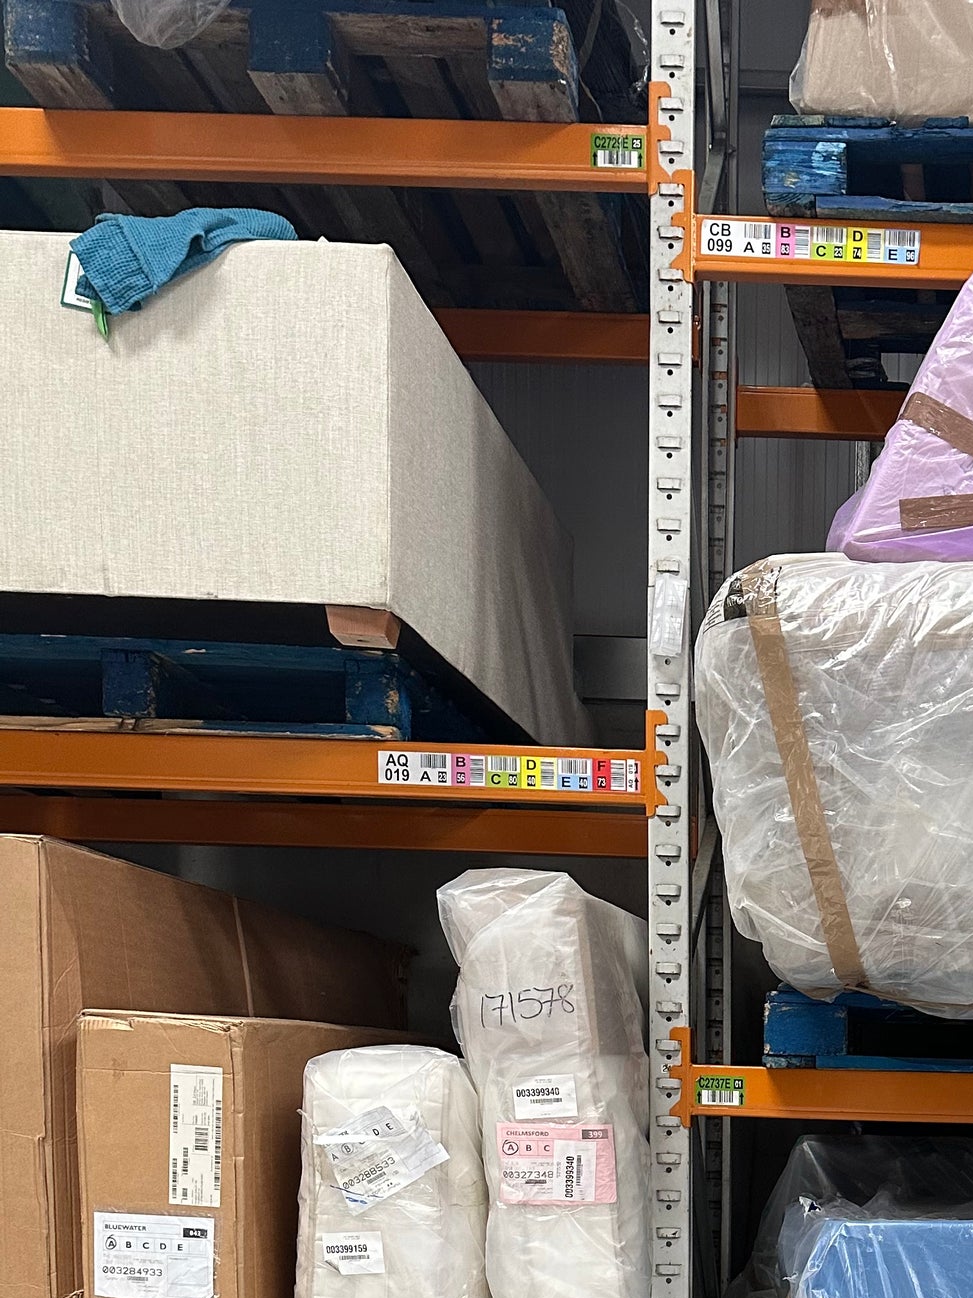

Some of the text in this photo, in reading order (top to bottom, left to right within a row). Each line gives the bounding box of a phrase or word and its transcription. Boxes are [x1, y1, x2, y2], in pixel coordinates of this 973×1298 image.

[633, 139, 641, 148] 25
[710, 223, 731, 236] CB
[781, 227, 790, 238] B
[853, 231, 863, 241] D
[708, 238, 771, 253] 099 A 35
[816, 246, 826, 256] C
[853, 248, 862, 258] 74
[888, 249, 915, 261] E 96
[386, 754, 408, 767] AQ
[456, 757, 466, 767] B
[527, 760, 536, 770] D
[598, 761, 606, 771] F
[385, 768, 447, 782] 019 A 23
[457, 773, 465, 783] 56
[491, 774, 501, 784] C
[562, 777, 571, 787] E
[480, 983, 575, 1029] 171578
[699, 1078, 742, 1088] C2737E 01
[516, 1087, 560, 1098] 003399340
[372, 1128, 380, 1136] D
[386, 1123, 393, 1131] E
[565, 1156, 574, 1198] 003399340
[326, 1244, 368, 1254] 003399159
[102, 1265, 163, 1276] 003284933
